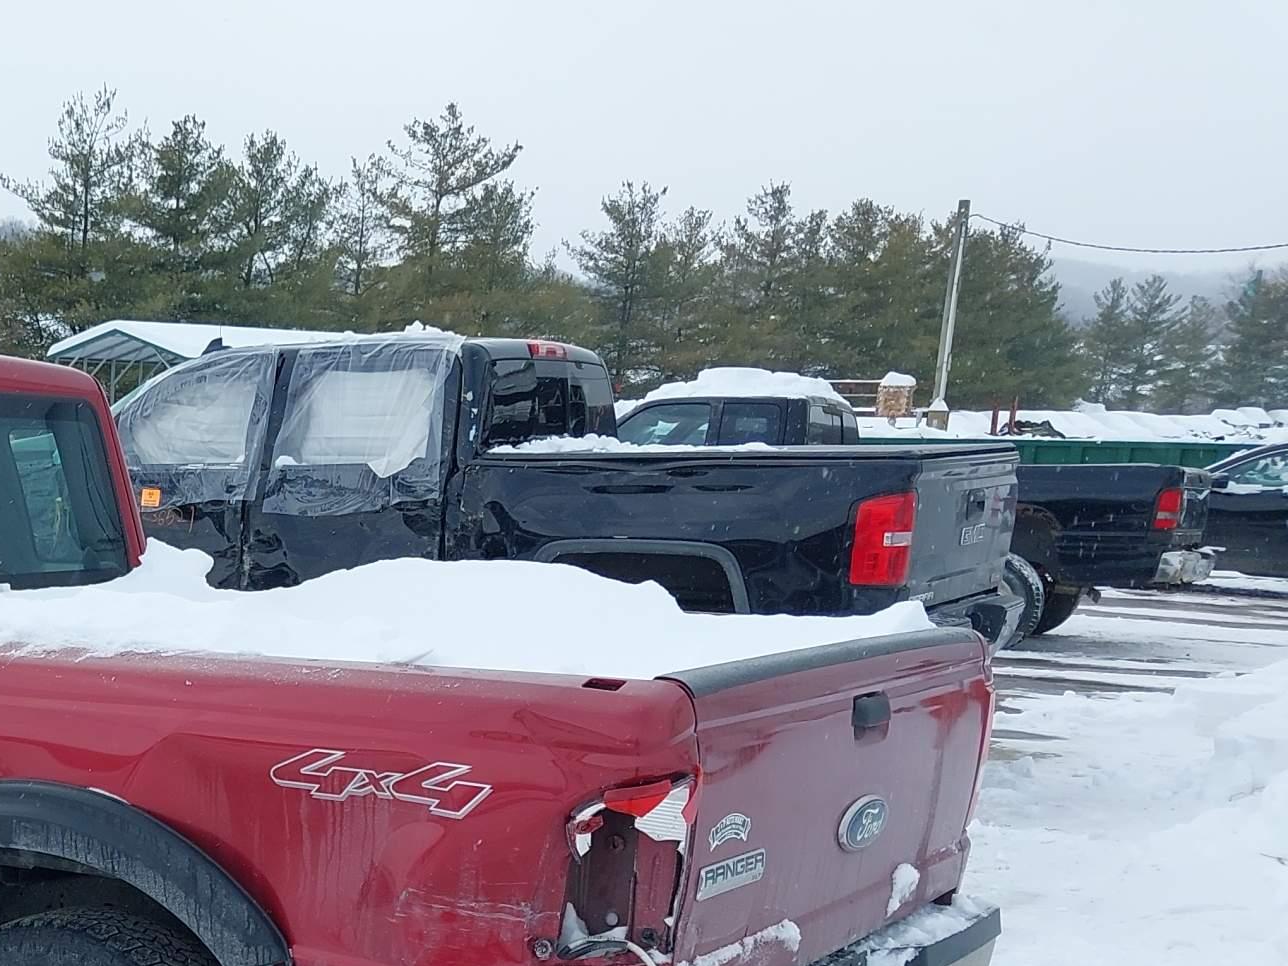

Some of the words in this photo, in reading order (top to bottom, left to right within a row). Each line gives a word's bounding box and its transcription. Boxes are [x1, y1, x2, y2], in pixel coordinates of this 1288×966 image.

[270, 749, 494, 820] 4x4
[856, 807, 884, 841] Ford
[704, 851, 764, 889] RANGER
